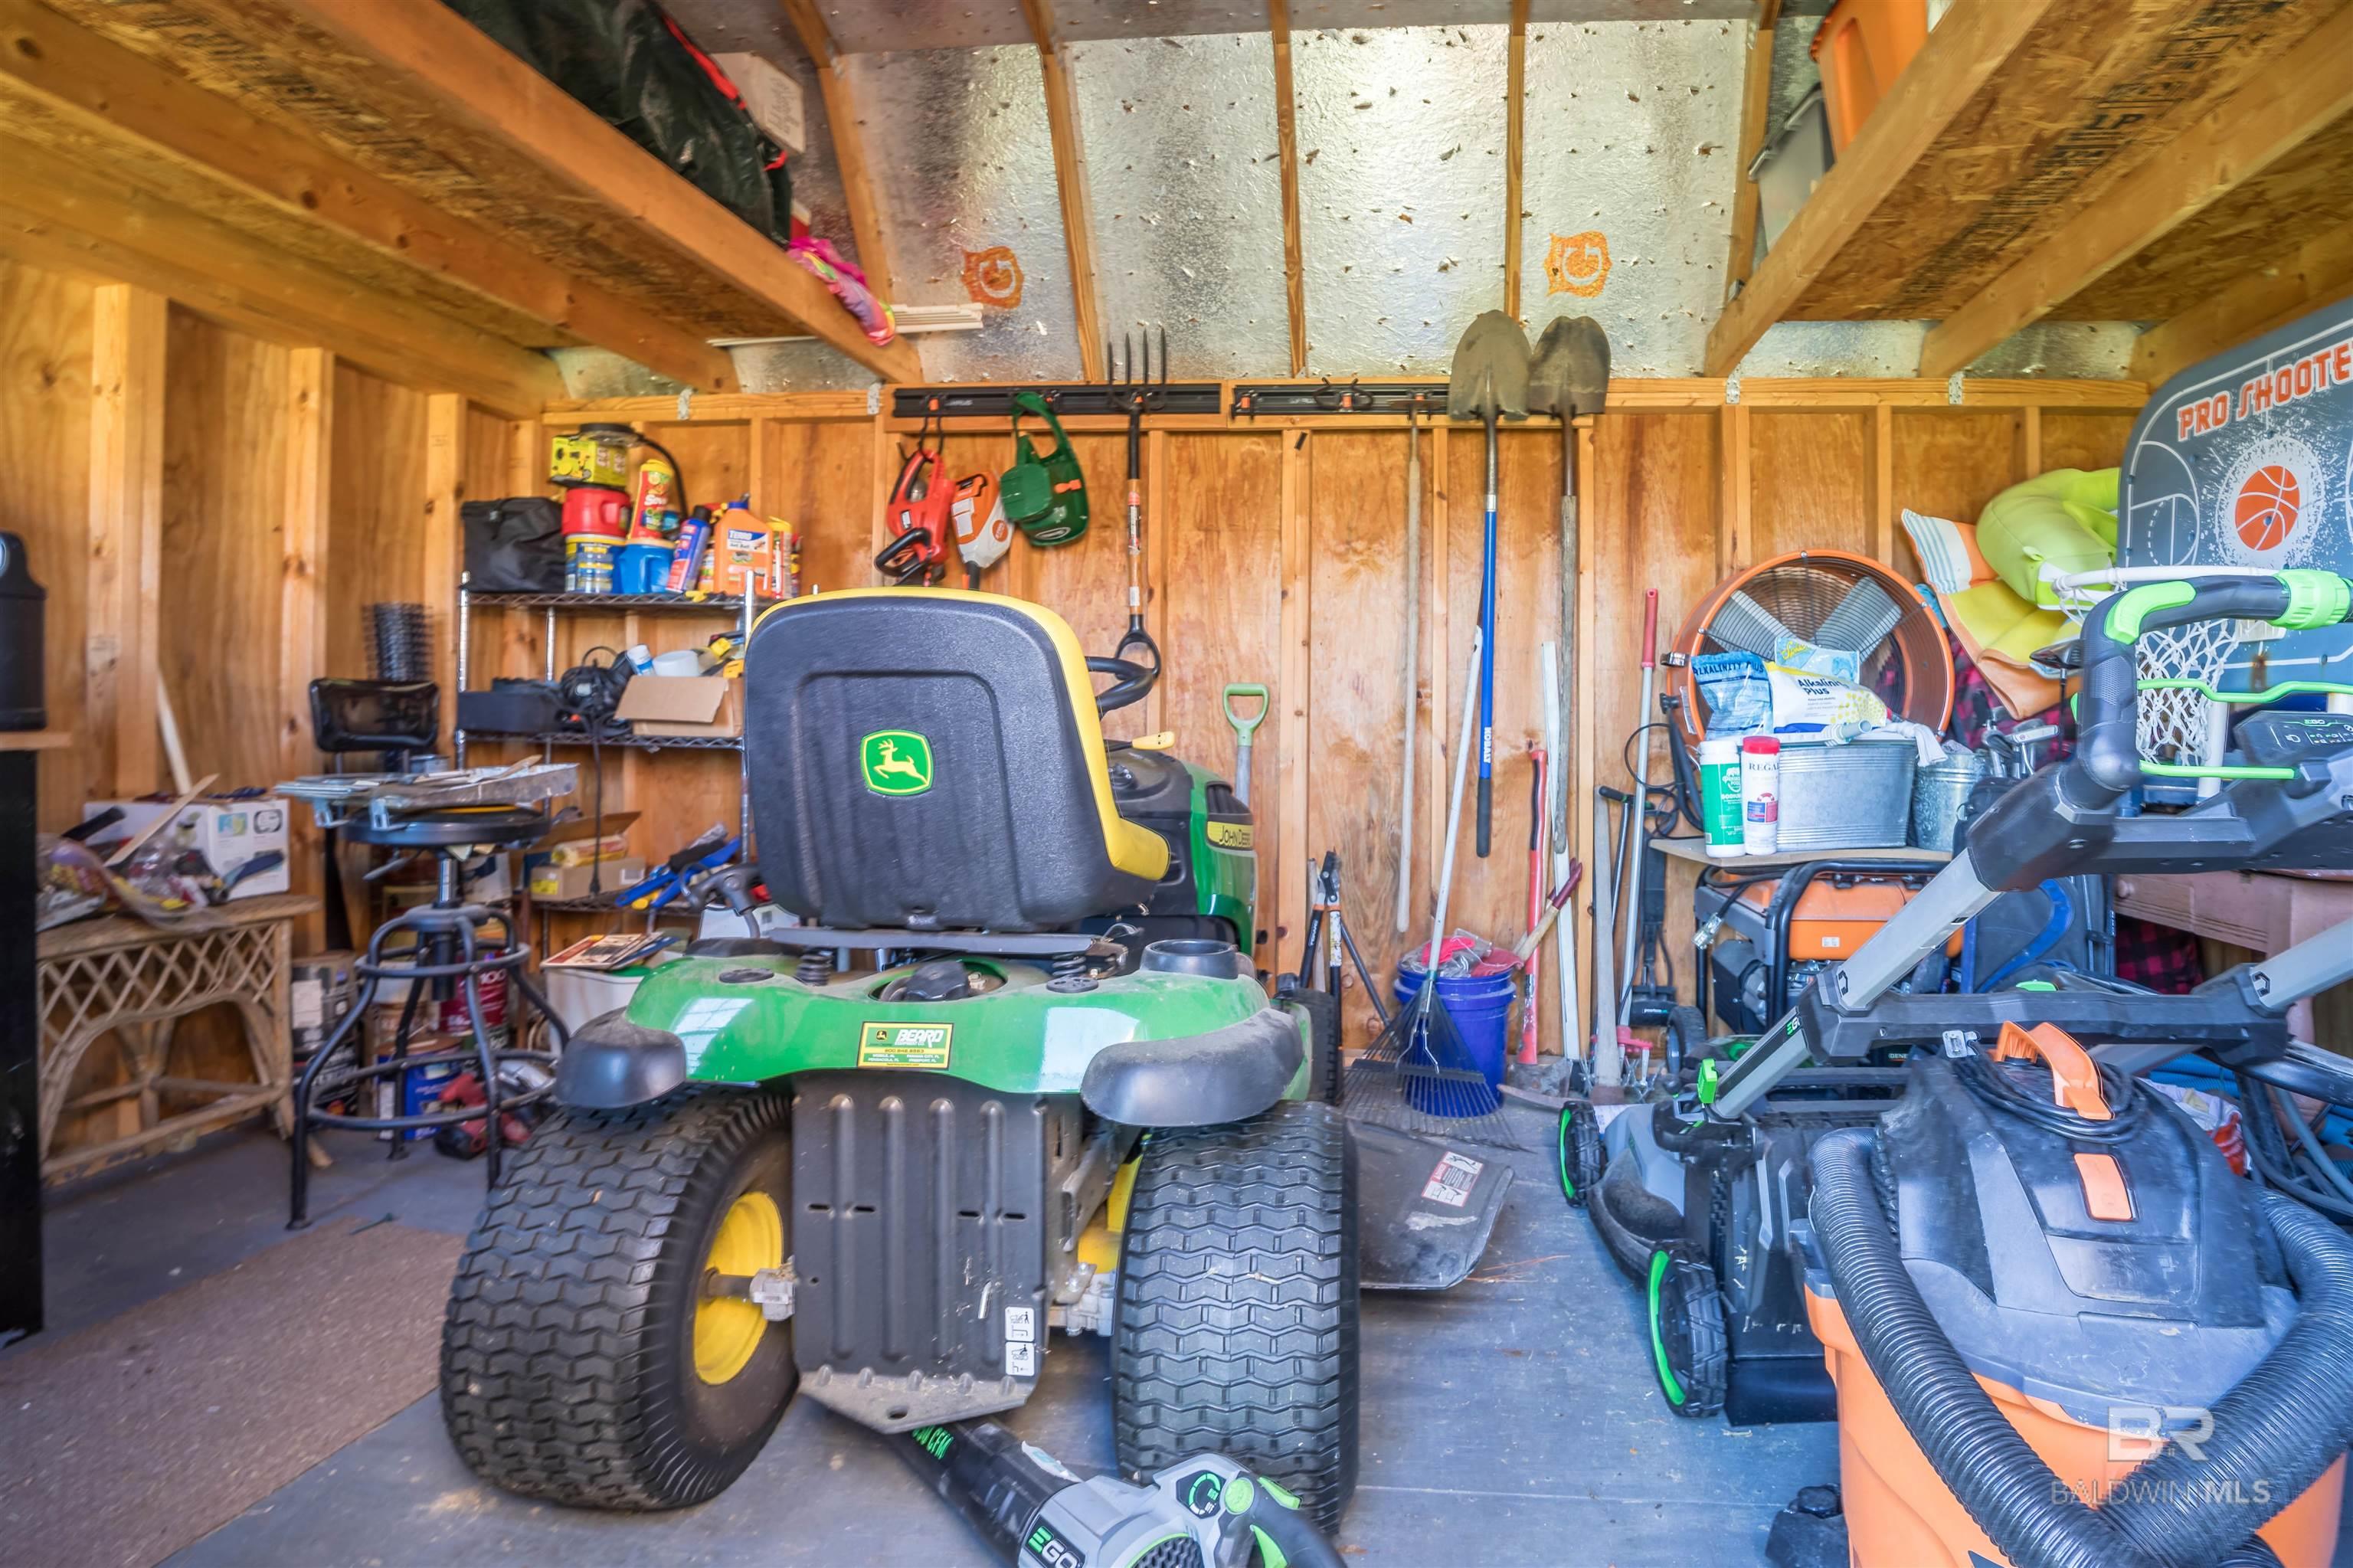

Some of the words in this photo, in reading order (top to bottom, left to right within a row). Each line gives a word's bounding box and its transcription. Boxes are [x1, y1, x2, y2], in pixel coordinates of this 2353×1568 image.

[2178, 391, 2231, 442] PRO
[2237, 337, 2353, 421] SHOOTE
[1804, 687, 1830, 696] Plus
[1483, 726, 1492, 764] KOBALT
[1219, 825, 1238, 844] JOHN
[895, 1029, 944, 1048] BEARD
[927, 1427, 954, 1460] CFM
[1029, 1526, 1078, 1568] EGO
